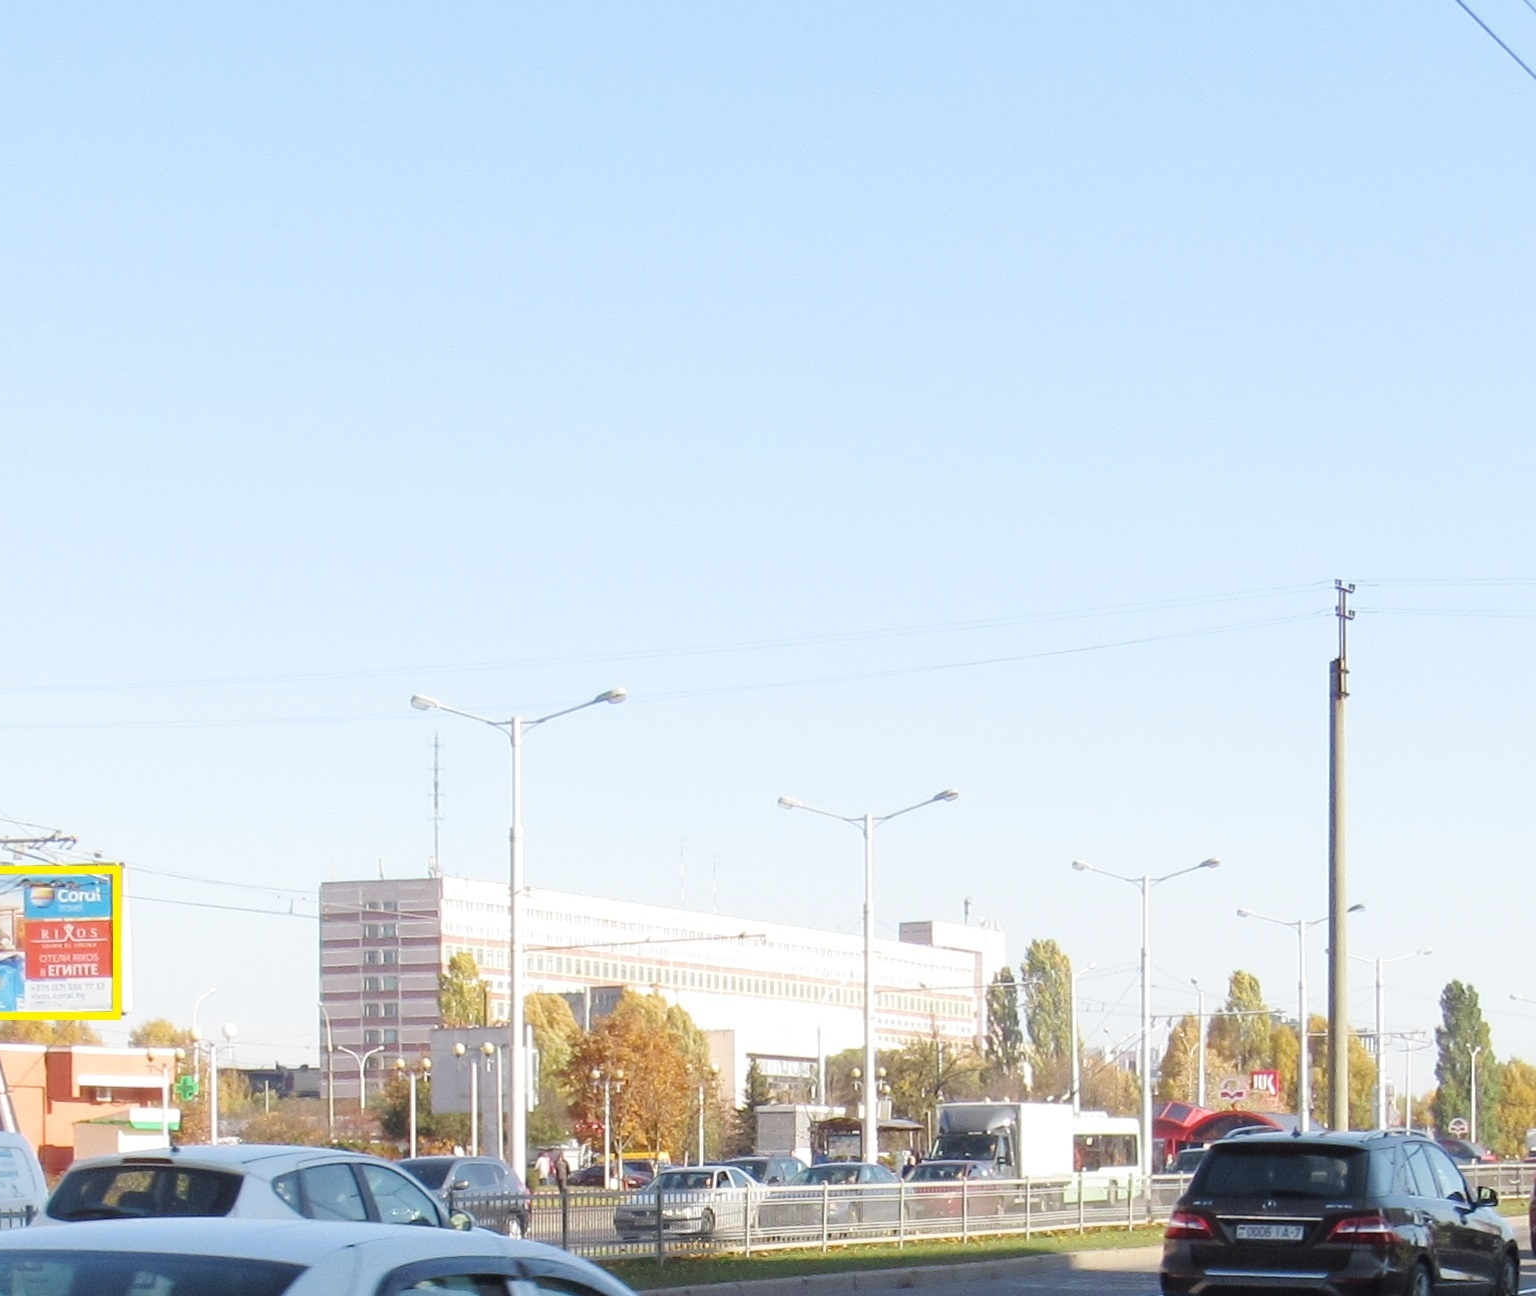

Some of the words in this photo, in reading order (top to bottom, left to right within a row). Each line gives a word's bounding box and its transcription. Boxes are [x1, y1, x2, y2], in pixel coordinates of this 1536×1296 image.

[41, 924, 99, 942] RIXOS
[39, 954, 71, 964] ОТЕЛИ
[48, 963, 100, 977] ЕГИПТЕ
